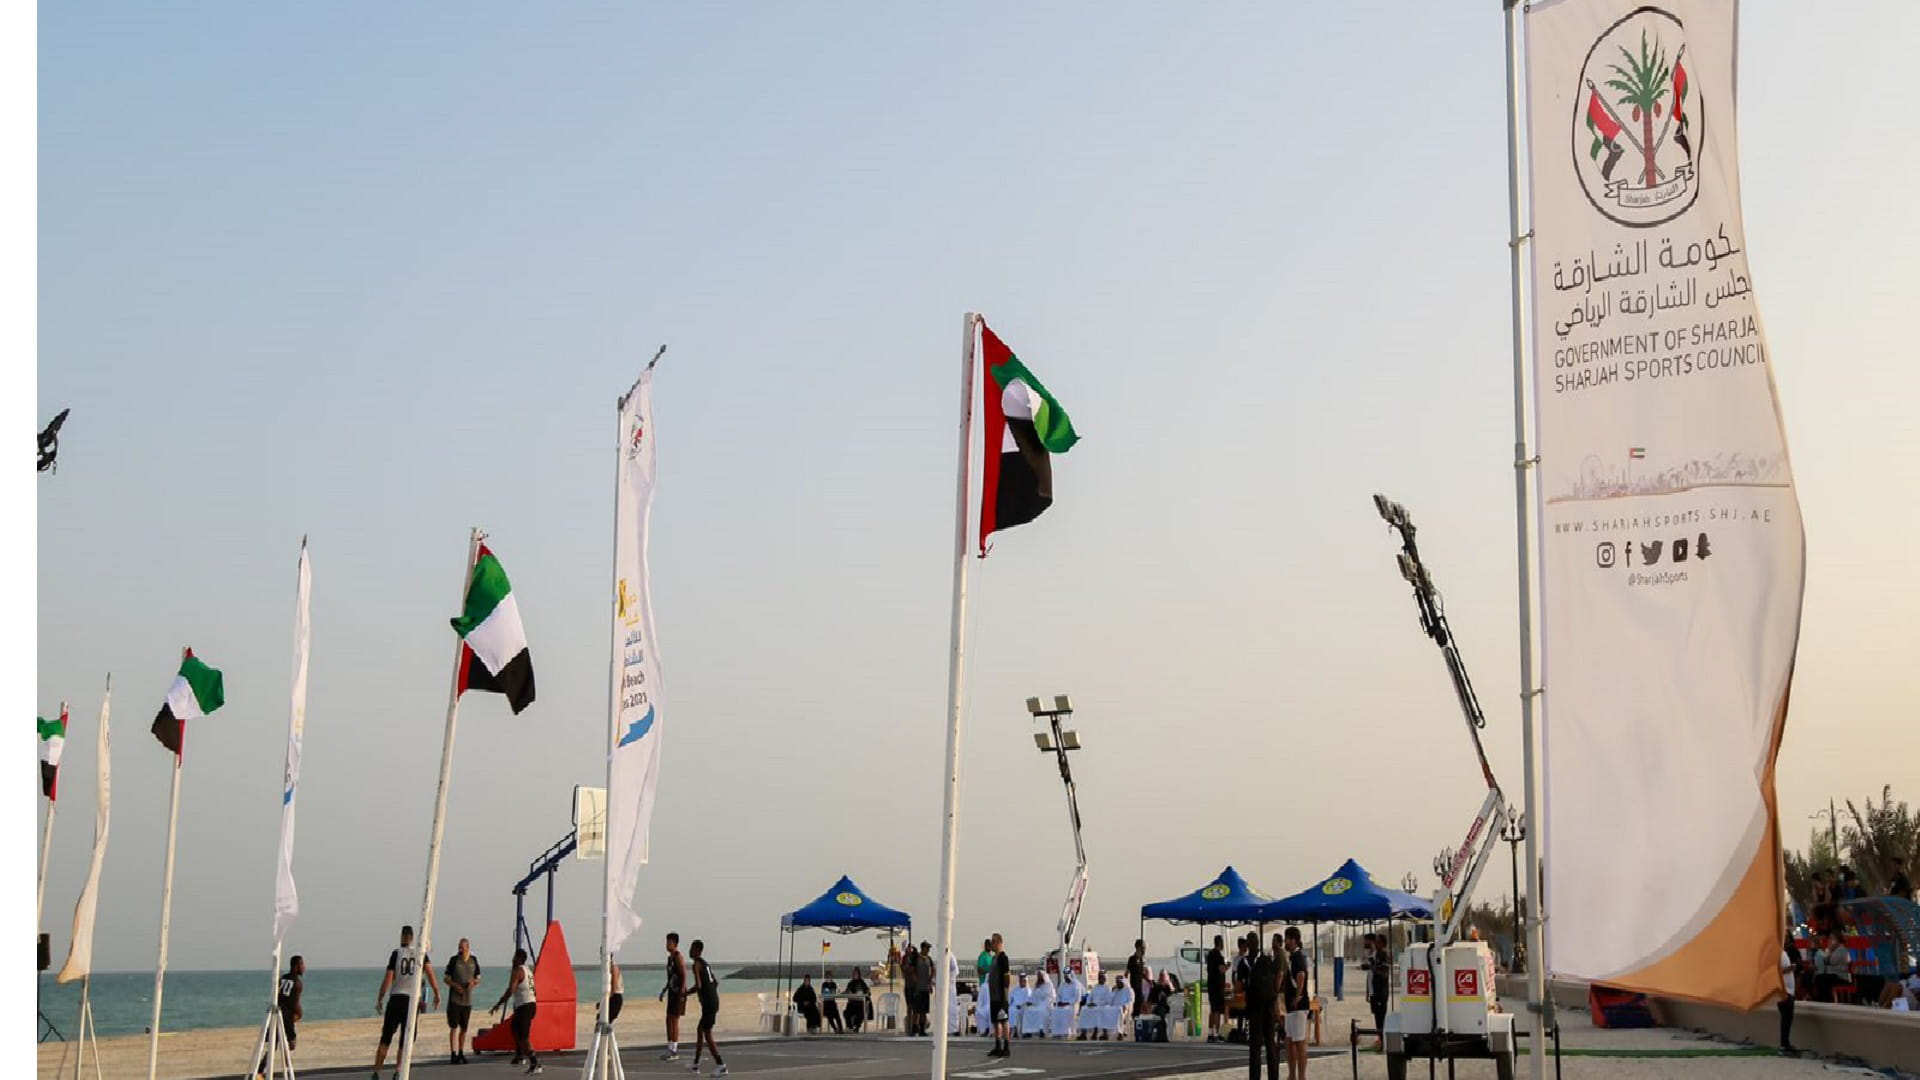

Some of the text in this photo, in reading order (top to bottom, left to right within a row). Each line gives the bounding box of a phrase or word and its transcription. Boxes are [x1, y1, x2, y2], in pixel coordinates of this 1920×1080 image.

[1553, 222, 1740, 294] كومة الشارقة
[1555, 268, 1752, 341] جلس الشارقة الرياضي
[1555, 315, 1758, 368] GOVERNMENT OF SHARJA
[1555, 363, 1618, 393] SHARJAH
[1624, 353, 1693, 381] SPORTS
